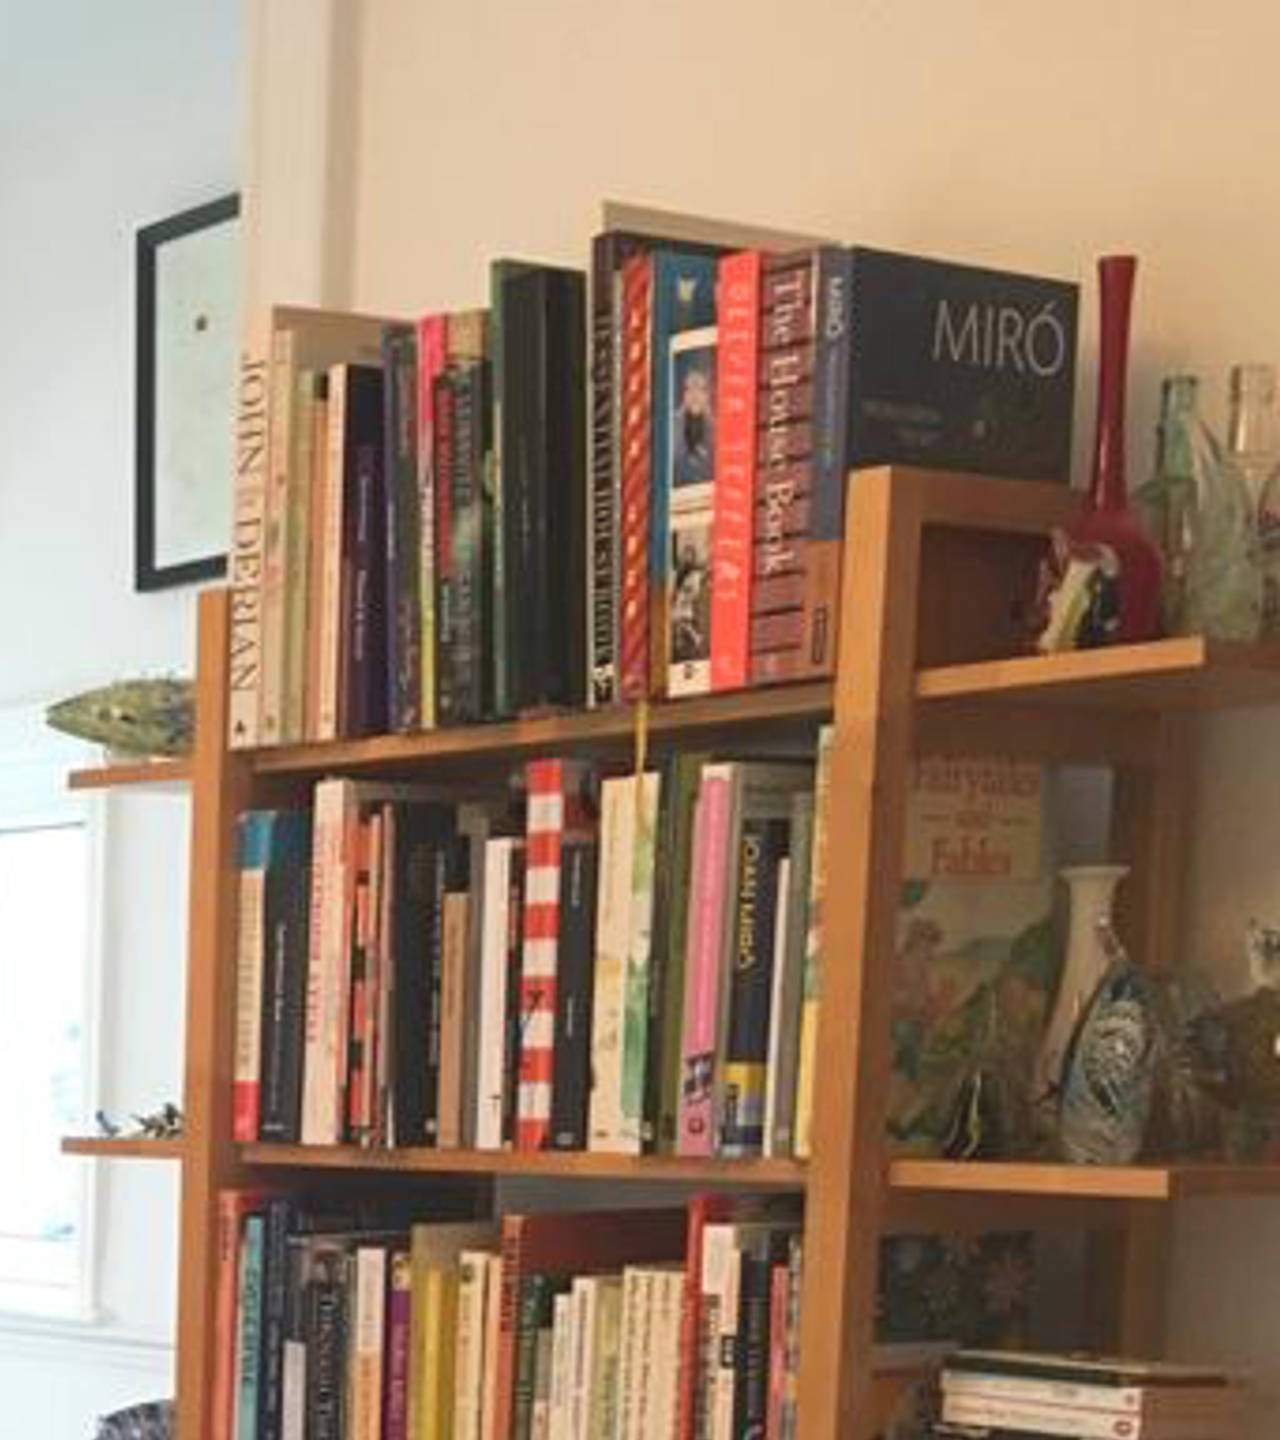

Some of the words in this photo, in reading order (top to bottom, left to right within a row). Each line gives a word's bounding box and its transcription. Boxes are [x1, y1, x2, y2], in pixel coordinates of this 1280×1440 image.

[770, 268, 805, 347] The
[932, 299, 1065, 377] MIRÓ
[236, 352, 266, 474] JOHN
[766, 353, 800, 471] House
[761, 479, 795, 574] Book
[230, 516, 262, 691] DERIAN
[740, 834, 761, 898] JOAN
